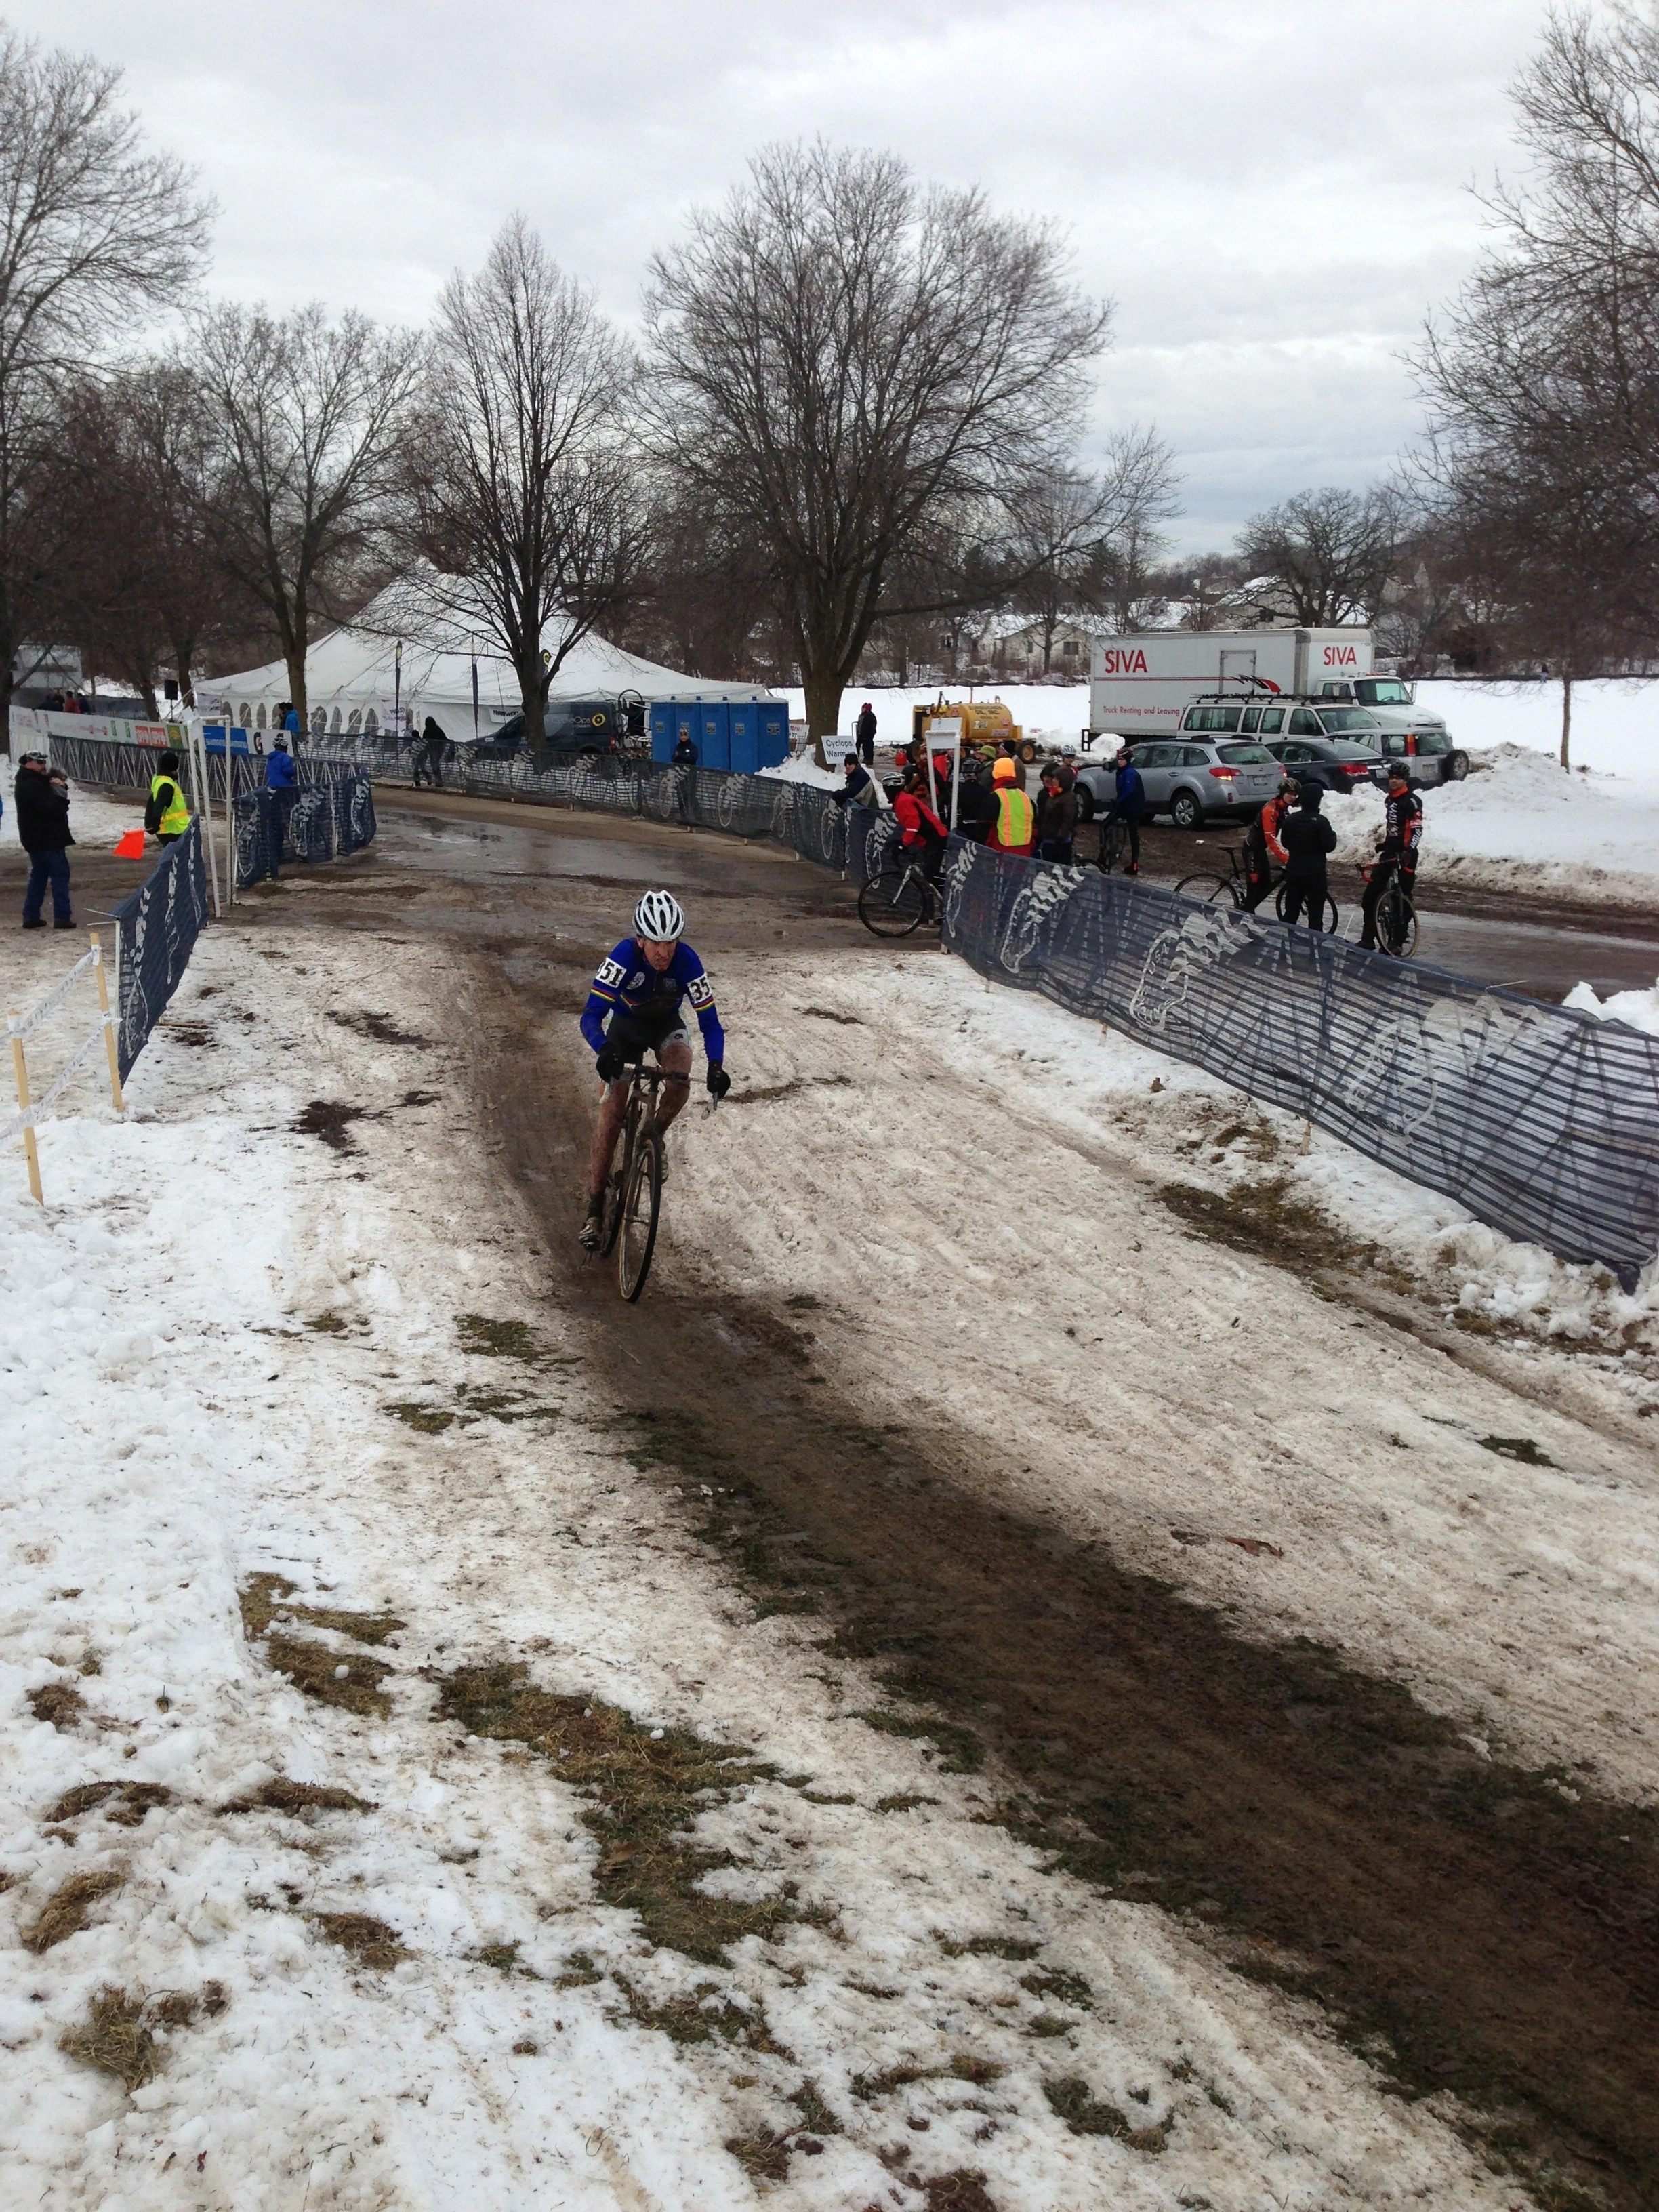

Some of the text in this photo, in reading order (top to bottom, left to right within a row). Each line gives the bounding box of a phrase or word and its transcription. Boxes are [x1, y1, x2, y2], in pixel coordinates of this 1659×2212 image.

[1105, 649, 1148, 674] SIVA
[1324, 647, 1357, 665] SIVA
[1120, 706, 1142, 716] Renting
[1143, 706, 1155, 714] and
[1157, 707, 1180, 716] Leasing
[826, 739, 853, 748] Cyclops
[596, 961, 623, 985] 51
[691, 976, 710, 1000] 35
